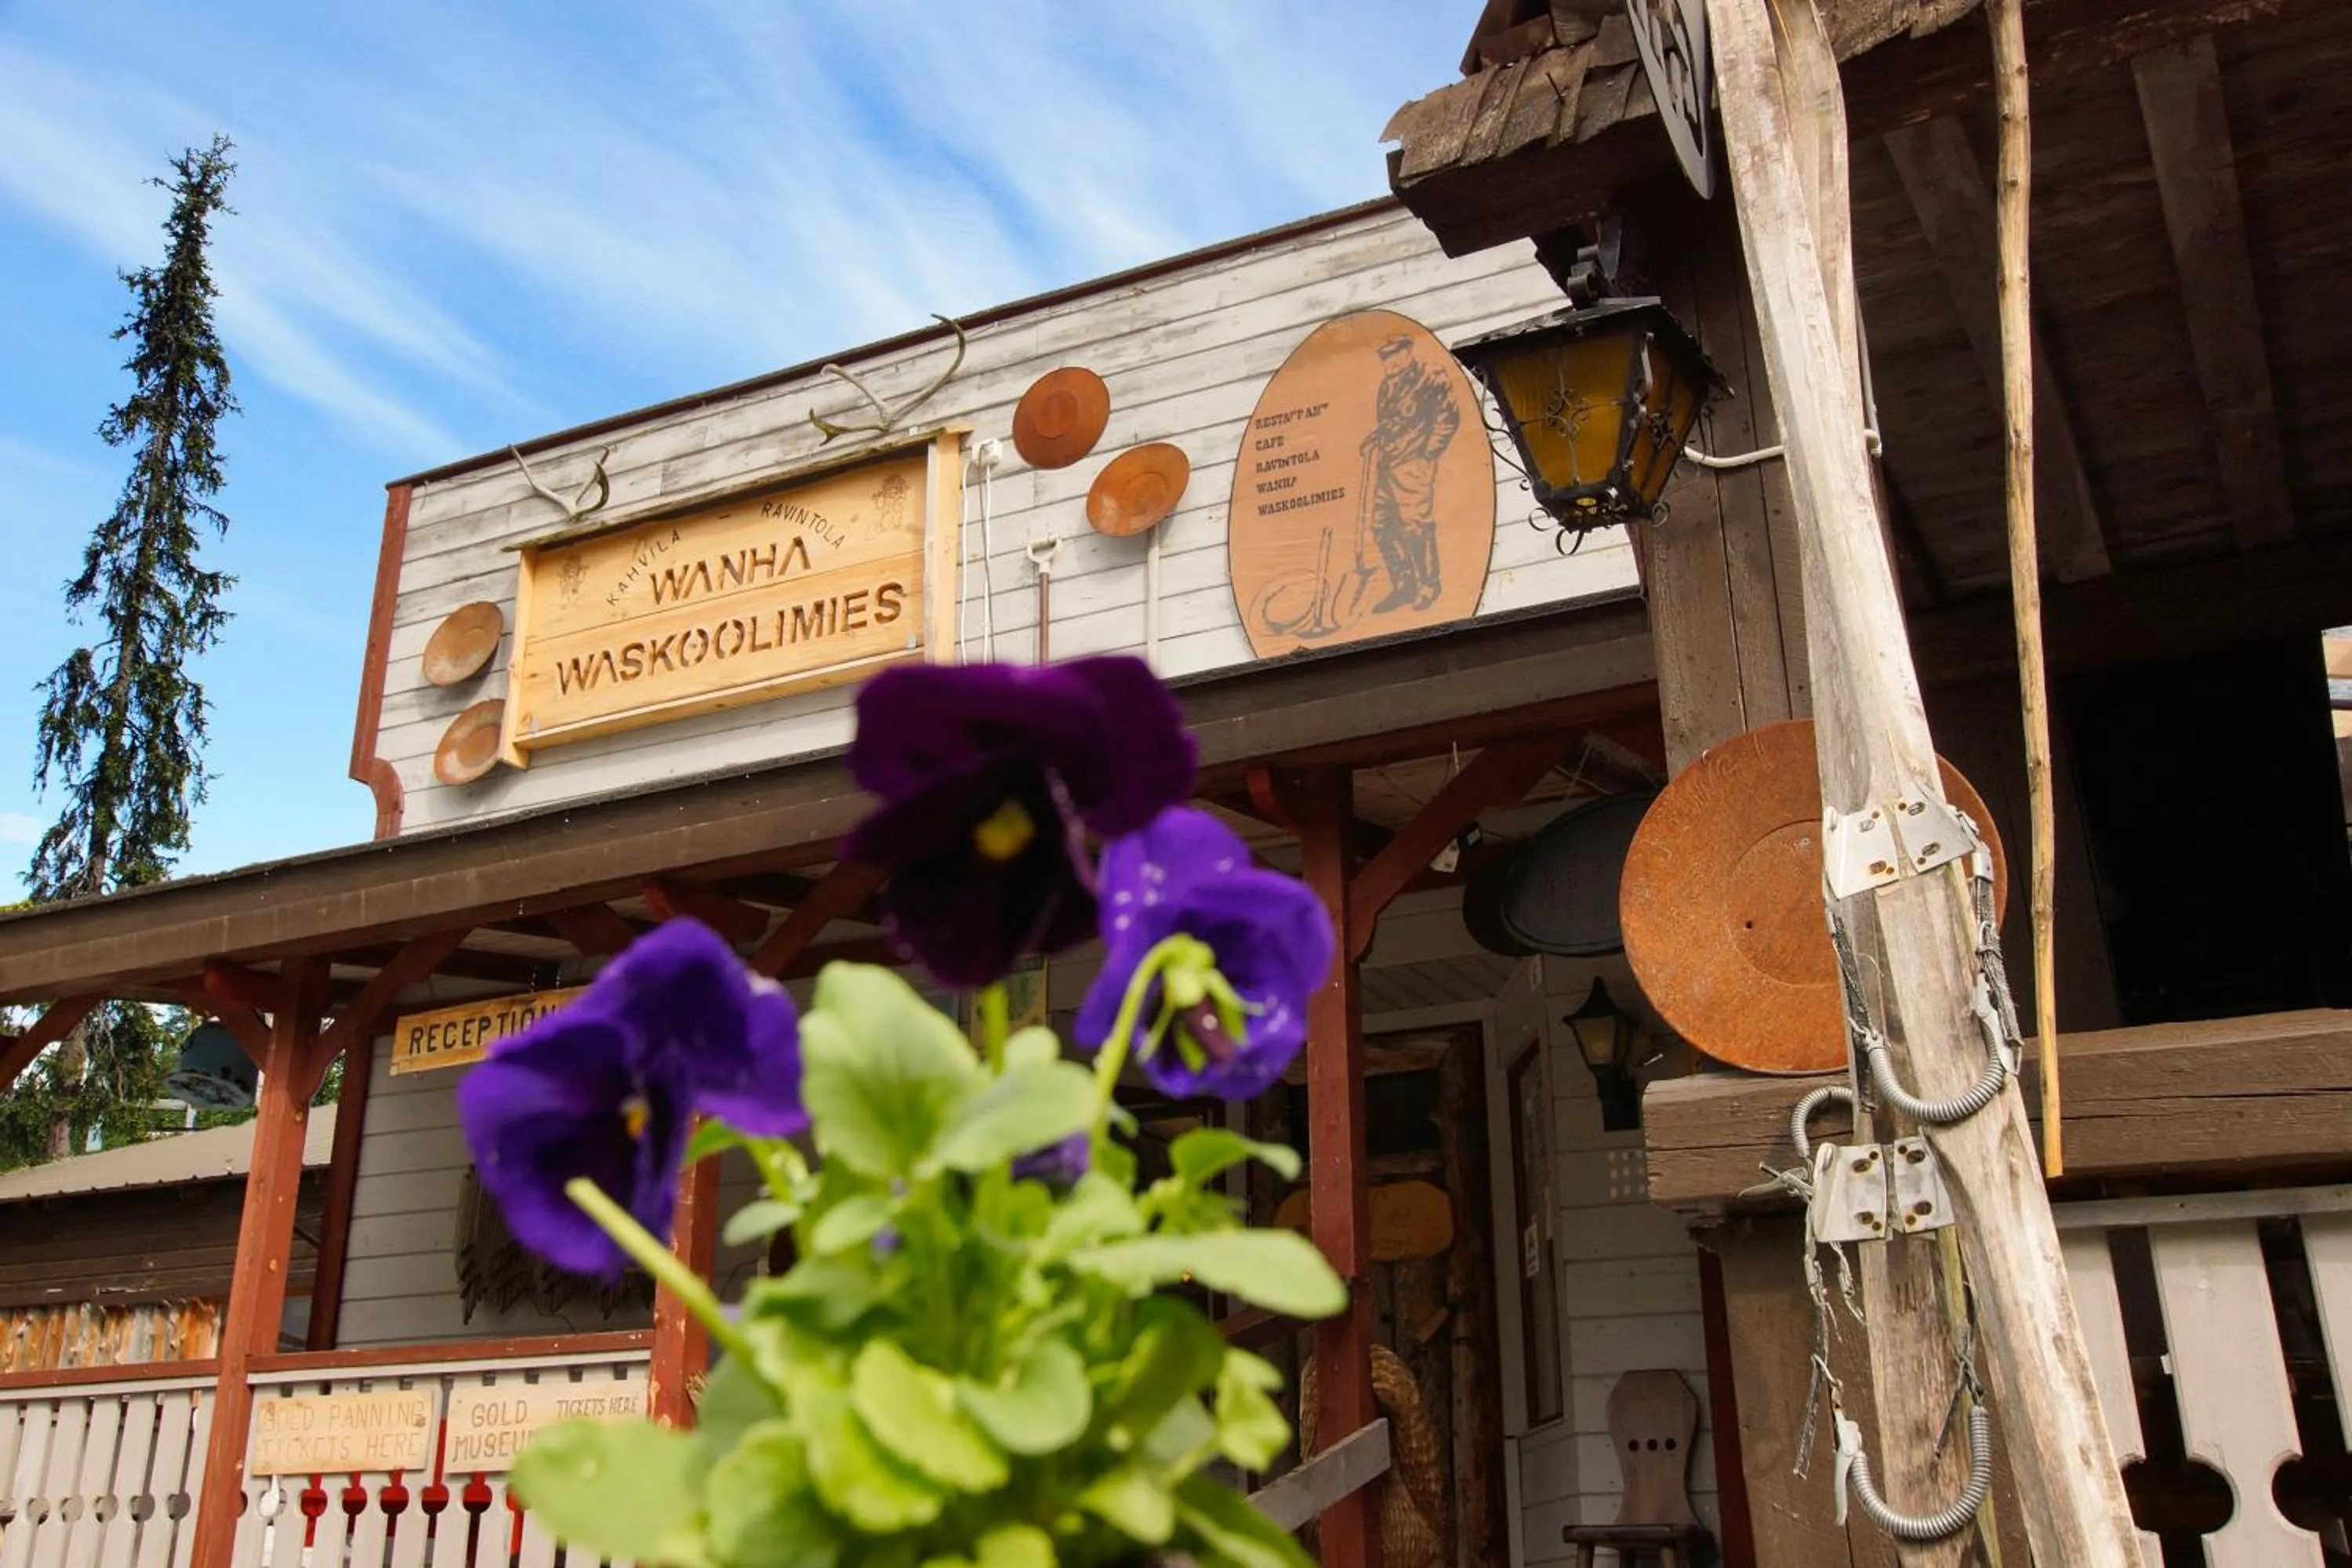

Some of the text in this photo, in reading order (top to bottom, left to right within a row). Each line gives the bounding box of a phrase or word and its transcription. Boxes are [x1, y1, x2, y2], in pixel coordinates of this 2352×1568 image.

[1255, 436, 1284, 451] CAFE
[1256, 449, 1320, 474] RAVINTOLA
[1258, 487, 1345, 516] WASKOOLIMIES
[606, 528, 681, 607] KAHVILA
[760, 501, 846, 550] RAVINTOLA
[650, 535, 811, 606] WANHA
[556, 582, 907, 695] WASKOOLIMIES
[262, 1400, 425, 1433] GOLD PANNING
[471, 1399, 528, 1428] GOLD
[556, 1393, 639, 1418] TICKETS HERE
[263, 1433, 421, 1461] TICKETS HERE
